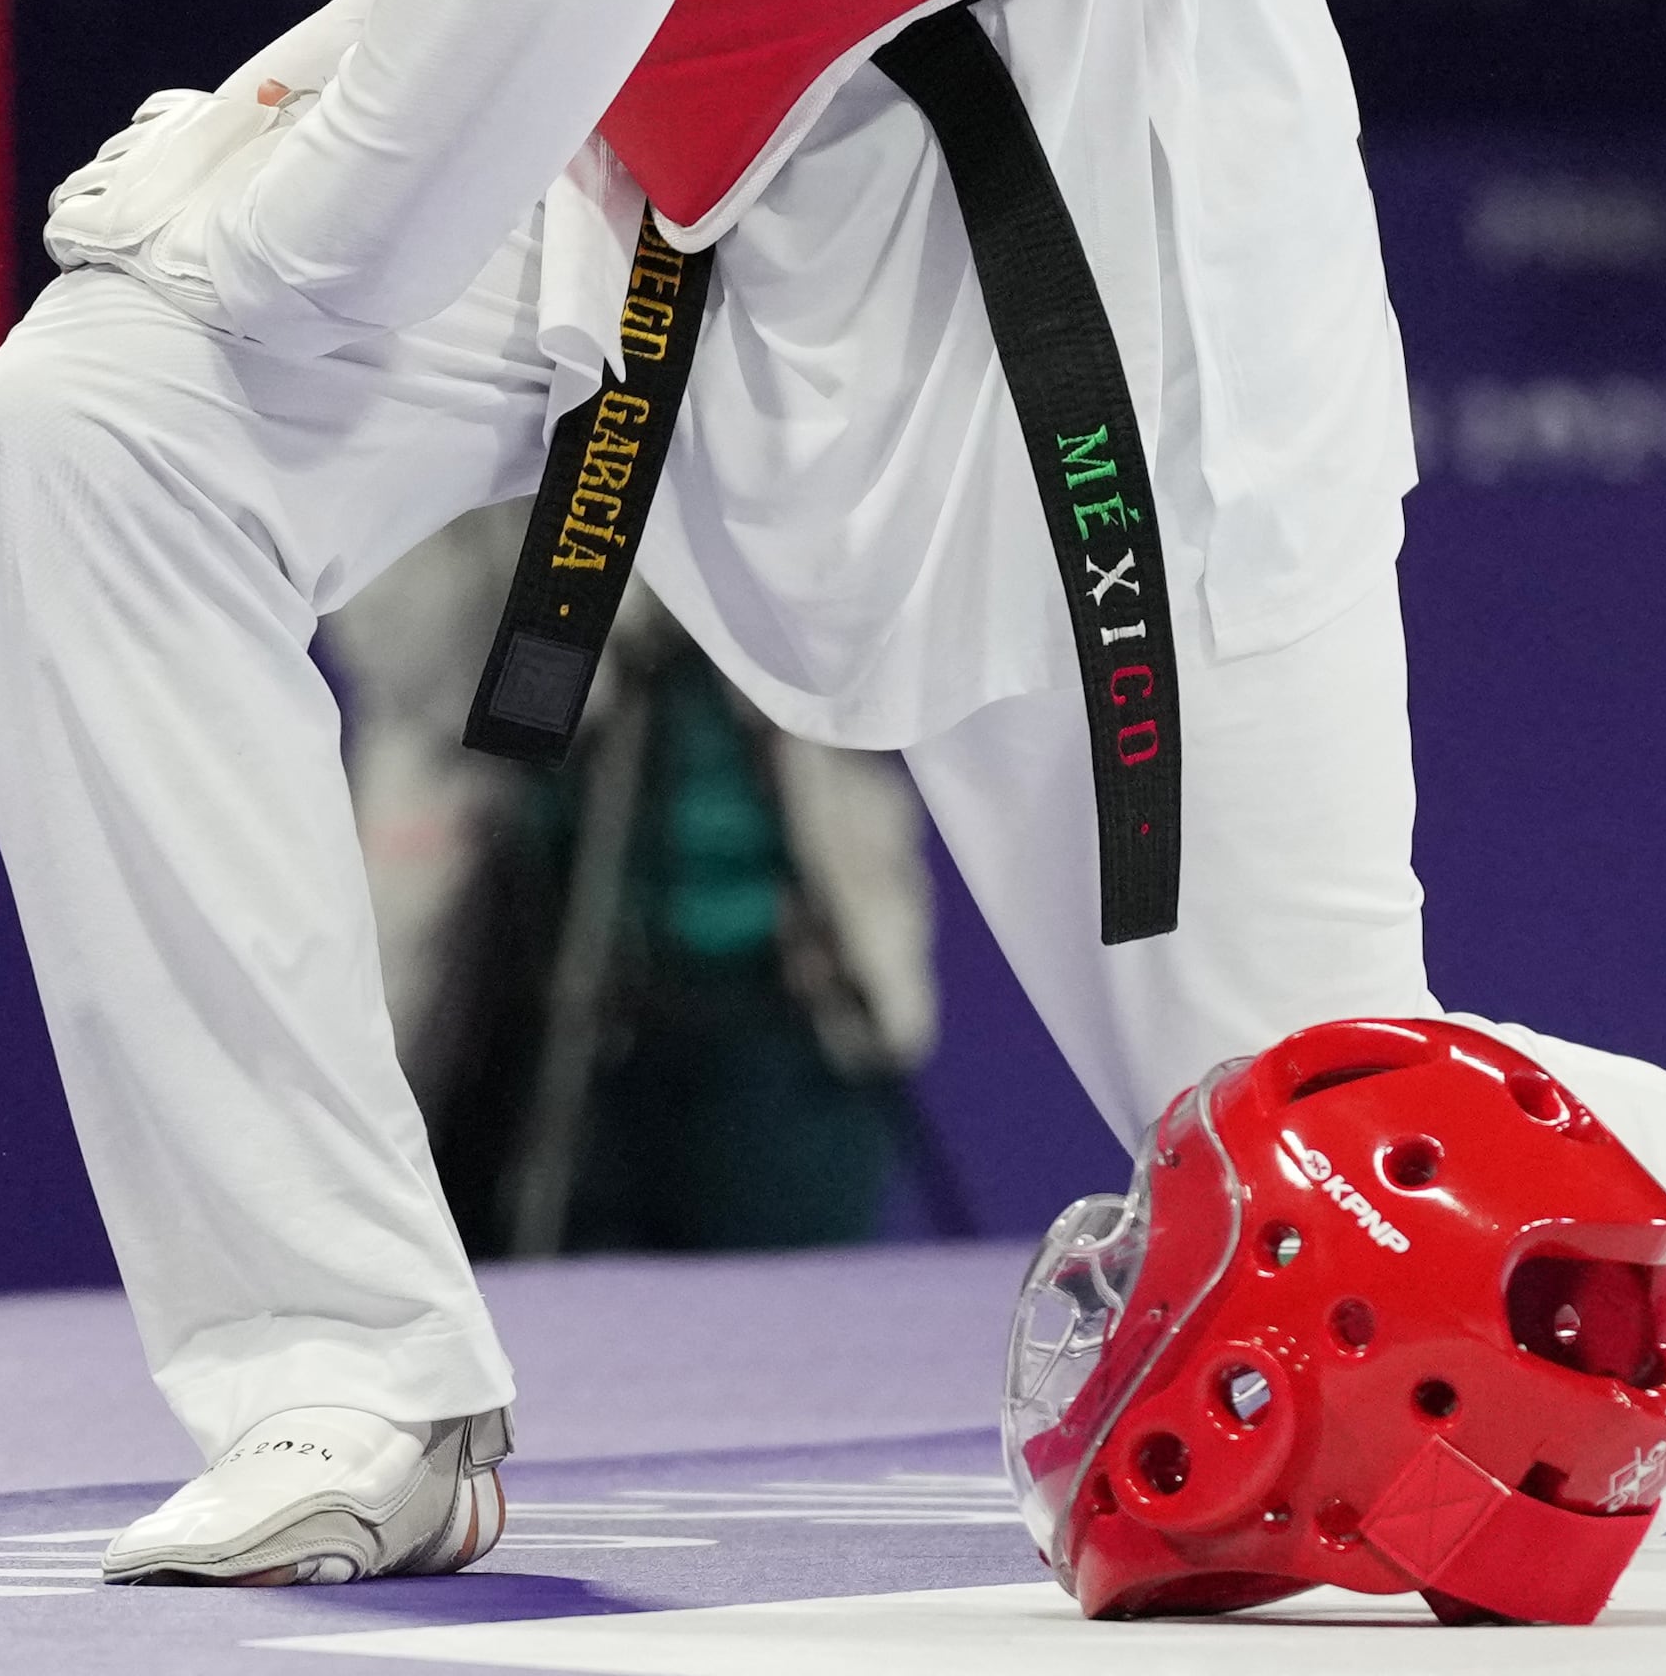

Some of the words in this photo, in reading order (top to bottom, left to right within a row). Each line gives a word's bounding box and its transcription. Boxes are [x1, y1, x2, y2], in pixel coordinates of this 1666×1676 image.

[551, 389, 650, 572] GARCÍA
[1056, 424, 1160, 767] MÉXICO
[1321, 1174, 1411, 1254] KPNP
[252, 1439, 333, 1462] 2024
